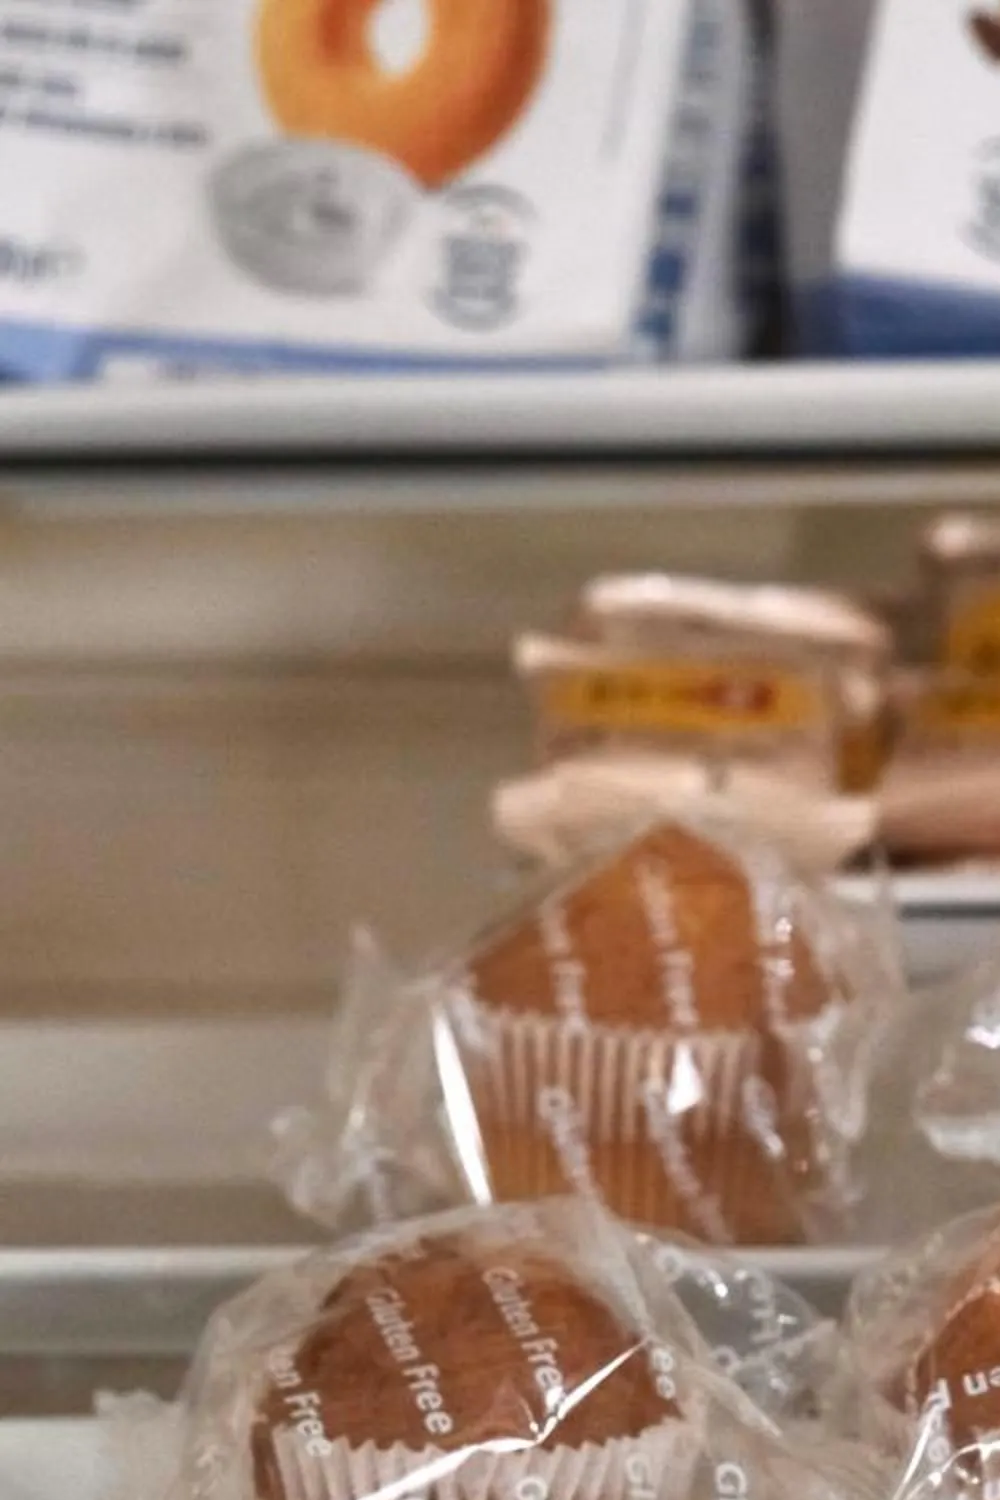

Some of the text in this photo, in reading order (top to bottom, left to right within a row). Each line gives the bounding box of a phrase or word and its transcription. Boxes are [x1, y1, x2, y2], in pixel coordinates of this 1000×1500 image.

[402, 1363, 453, 1434] Free
[652, 1346, 677, 1399] ee
[283, 1391, 332, 1457] Free
